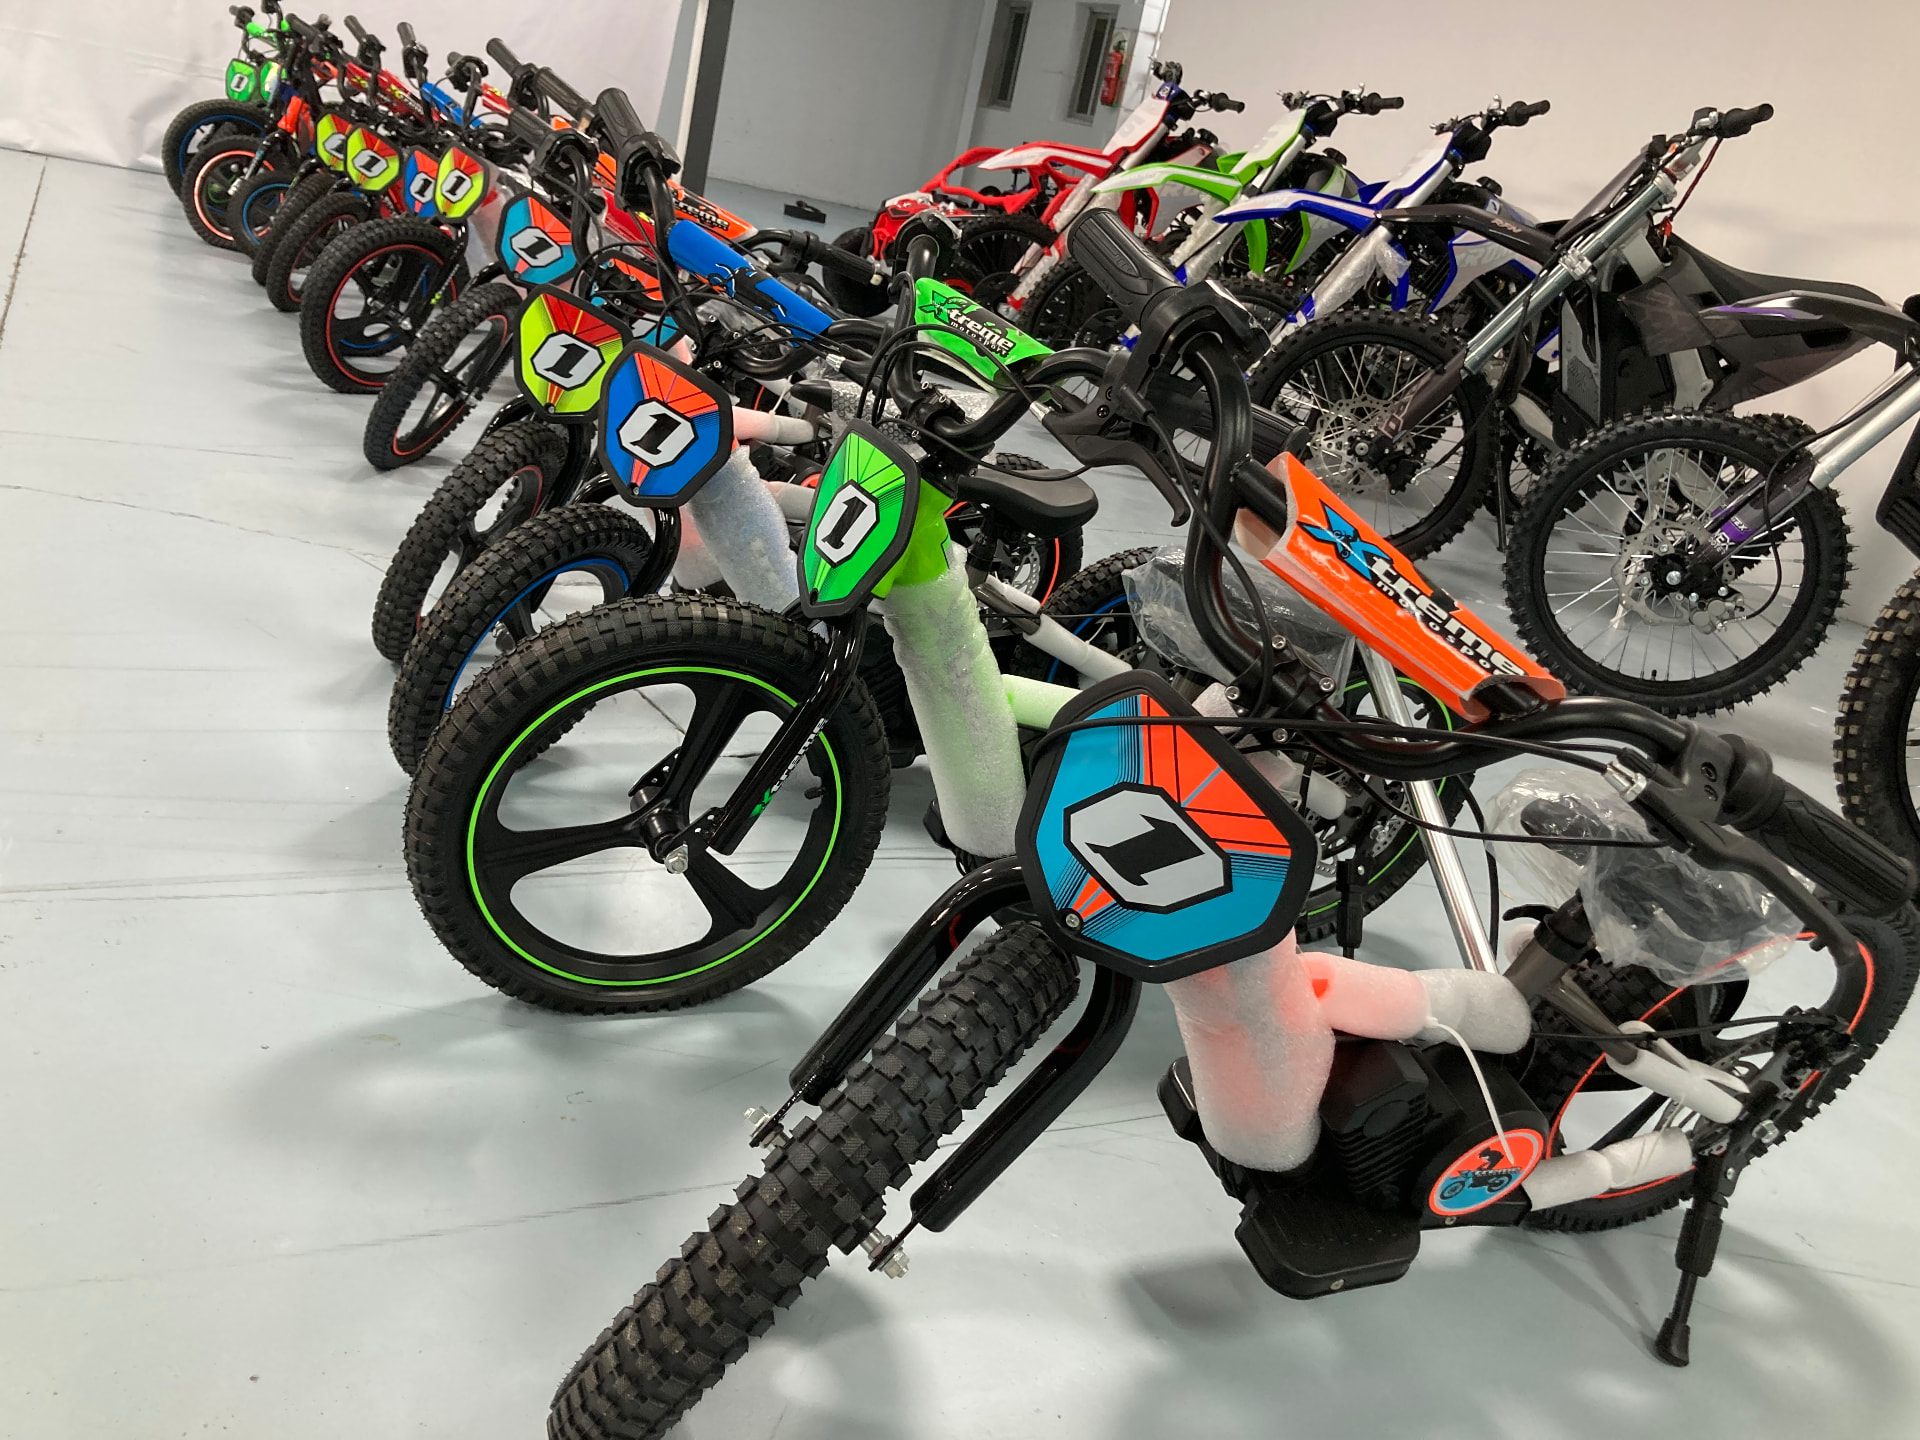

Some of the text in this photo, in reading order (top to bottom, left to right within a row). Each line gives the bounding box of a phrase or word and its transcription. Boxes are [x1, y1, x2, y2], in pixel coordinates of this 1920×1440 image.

[233, 76, 245, 89] 1
[359, 154, 381, 173] 1
[415, 177, 433, 197] 1
[447, 175, 467, 196] 1
[518, 235, 554, 260] 1
[918, 290, 1015, 350] Xtreme
[543, 342, 590, 379] 1
[629, 412, 682, 455] 1
[821, 496, 868, 550] 1
[1296, 498, 1525, 677] Xtreme
[1084, 813, 1206, 887] 1
